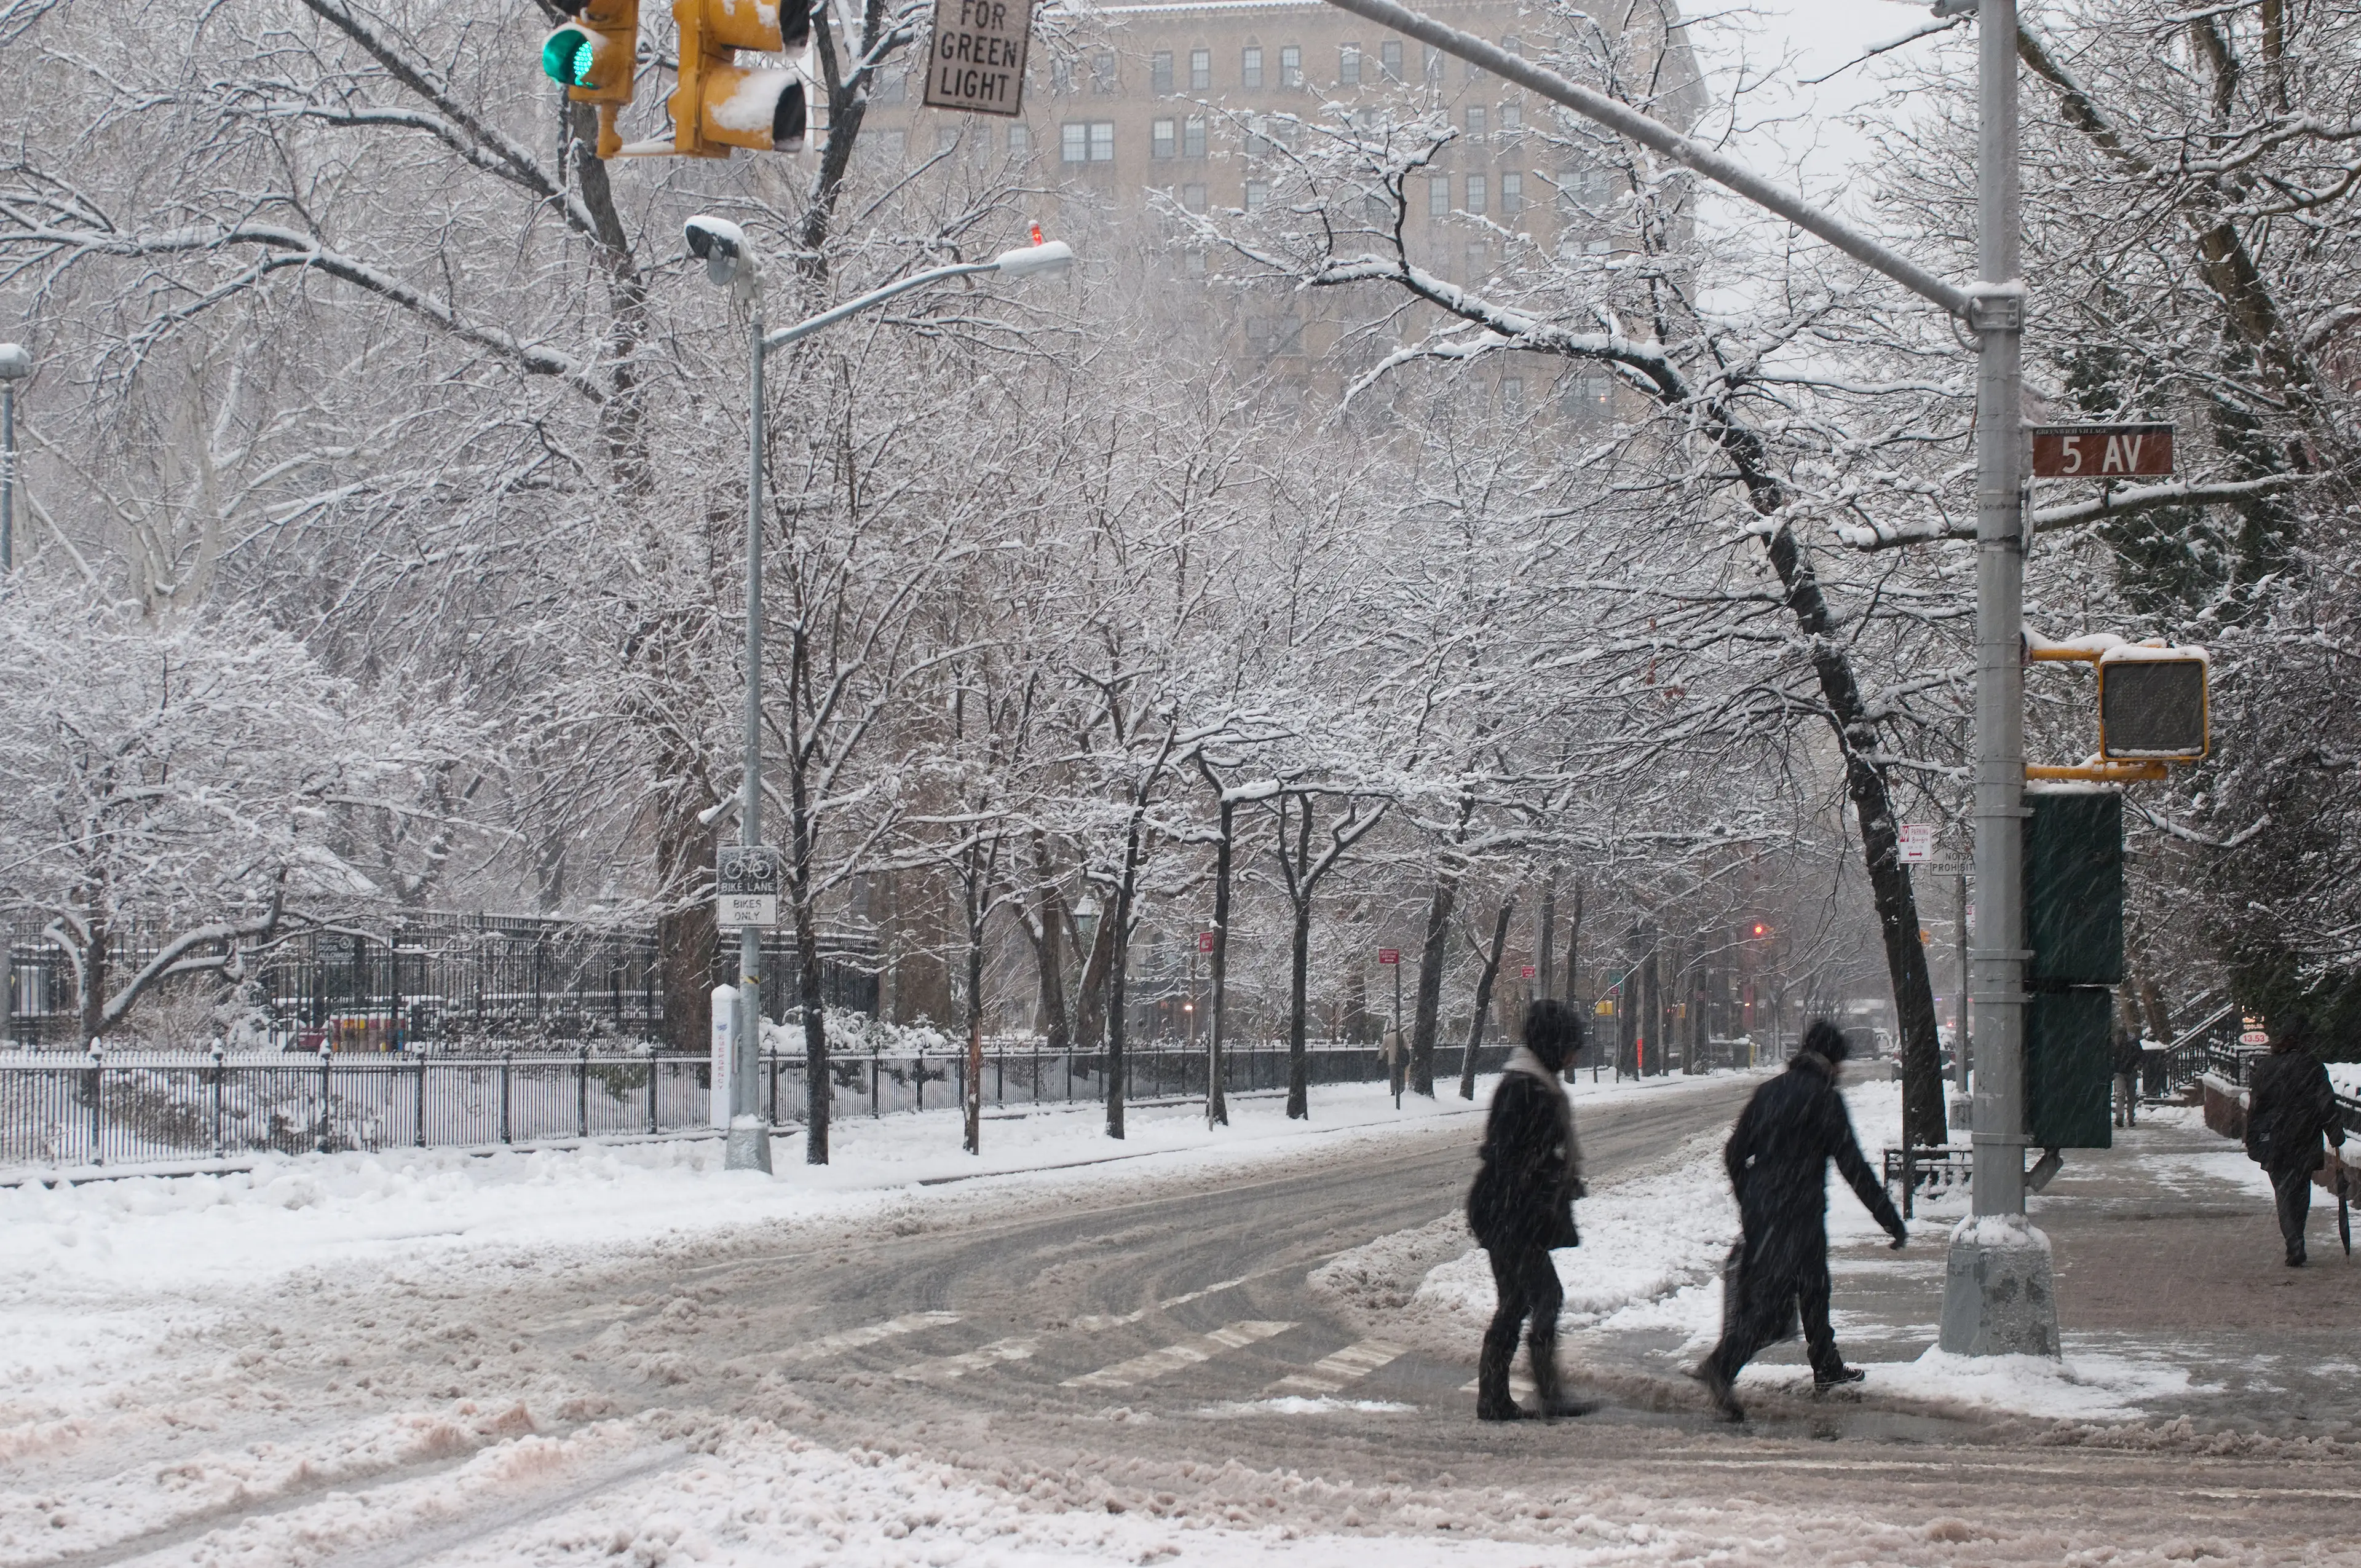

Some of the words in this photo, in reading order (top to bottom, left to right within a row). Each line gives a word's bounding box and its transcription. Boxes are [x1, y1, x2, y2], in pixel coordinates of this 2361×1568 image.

[960, 0, 1006, 31] FOR
[941, 32, 1018, 68] GREEN
[941, 68, 1009, 102] LIGHT
[2062, 436, 2082, 473] 5
[2102, 435, 2143, 472] AV
[721, 883, 743, 891] BIKE
[748, 882, 774, 891] LANE
[734, 899, 762, 908] BIKES
[734, 912, 760, 920] ONLY
